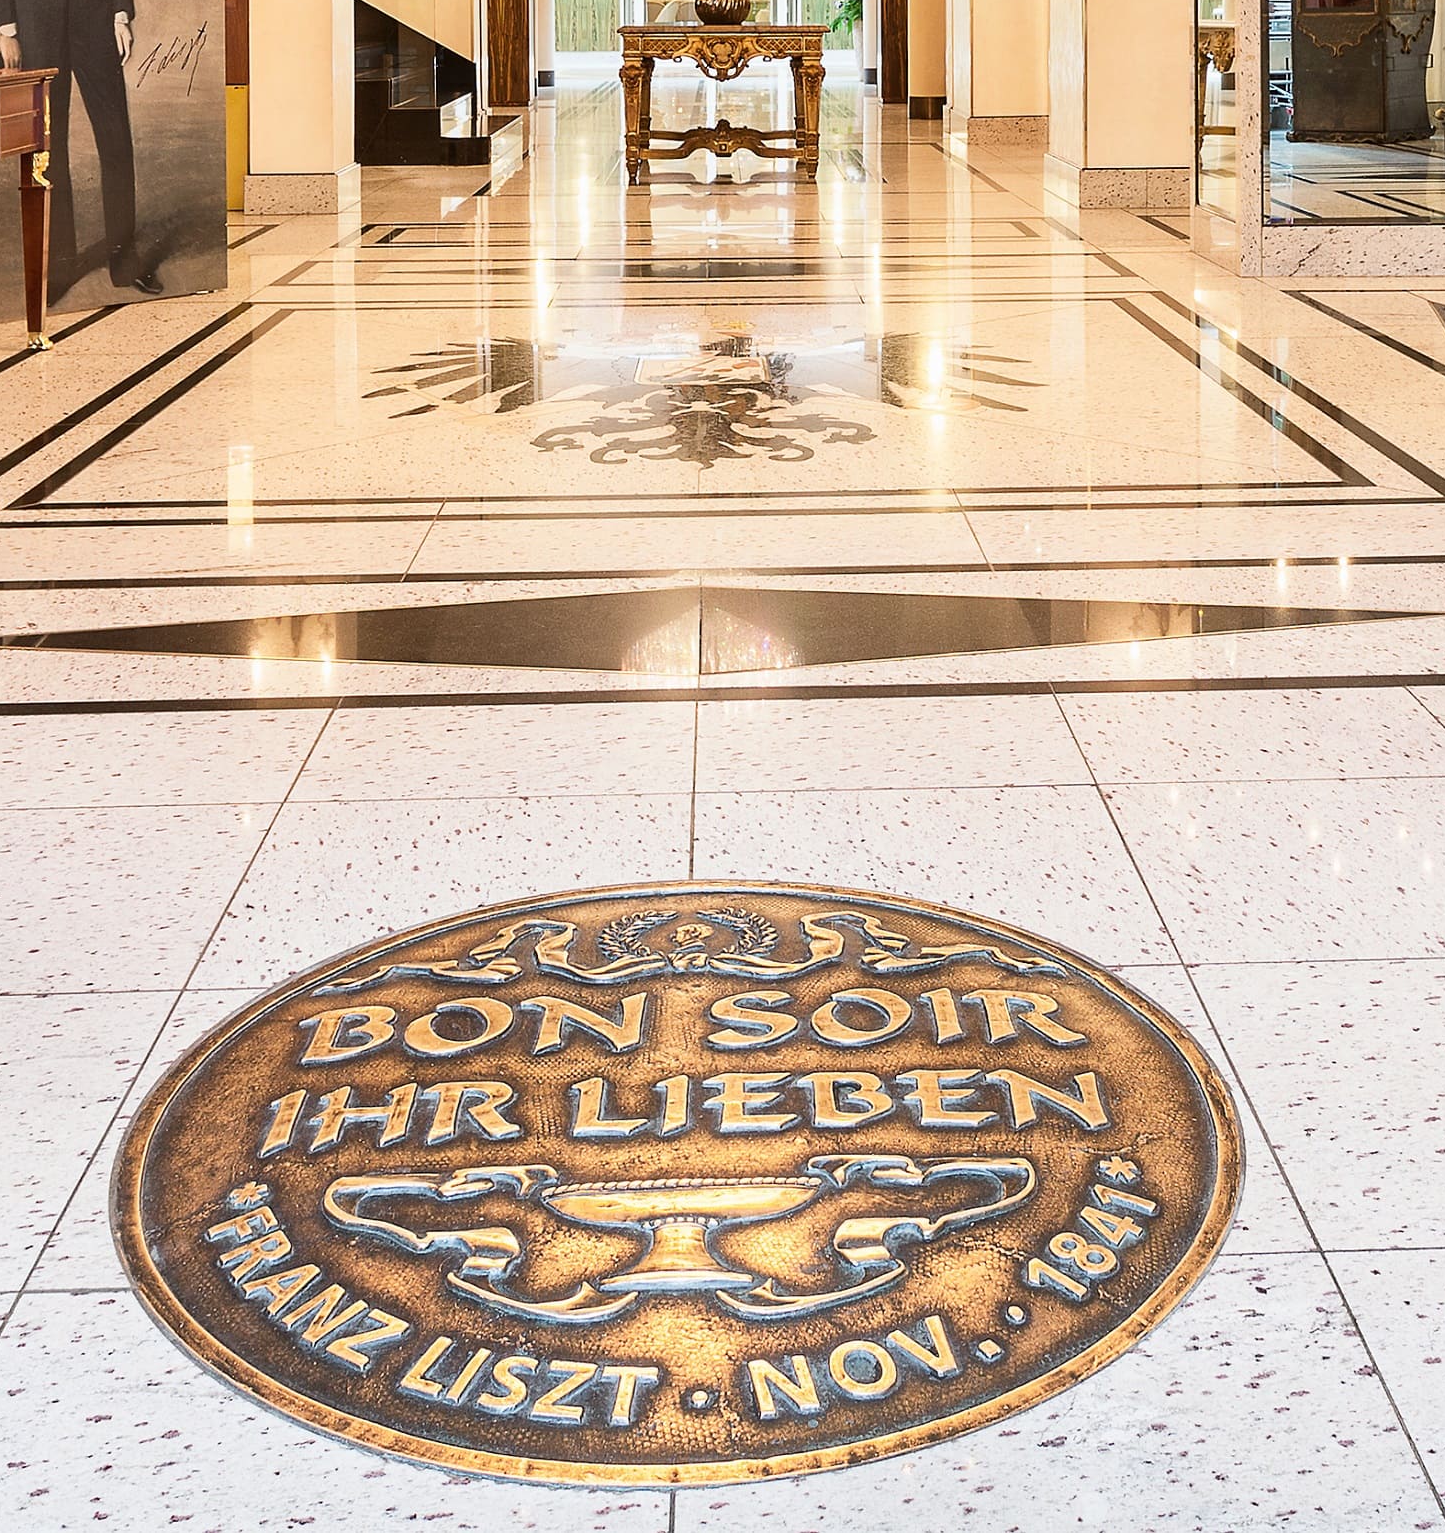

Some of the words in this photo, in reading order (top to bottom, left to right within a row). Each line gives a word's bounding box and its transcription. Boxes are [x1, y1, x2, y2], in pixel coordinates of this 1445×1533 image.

[300, 992, 648, 1065] BON
[708, 986, 1090, 1050] SOIR
[257, 1078, 523, 1158] IHR
[571, 1068, 1112, 1138] LIEBEN
[205, 1205, 411, 1373] FRANZ
[399, 1335, 660, 1427] LISZT
[1025, 1183, 1160, 1303] 1841
